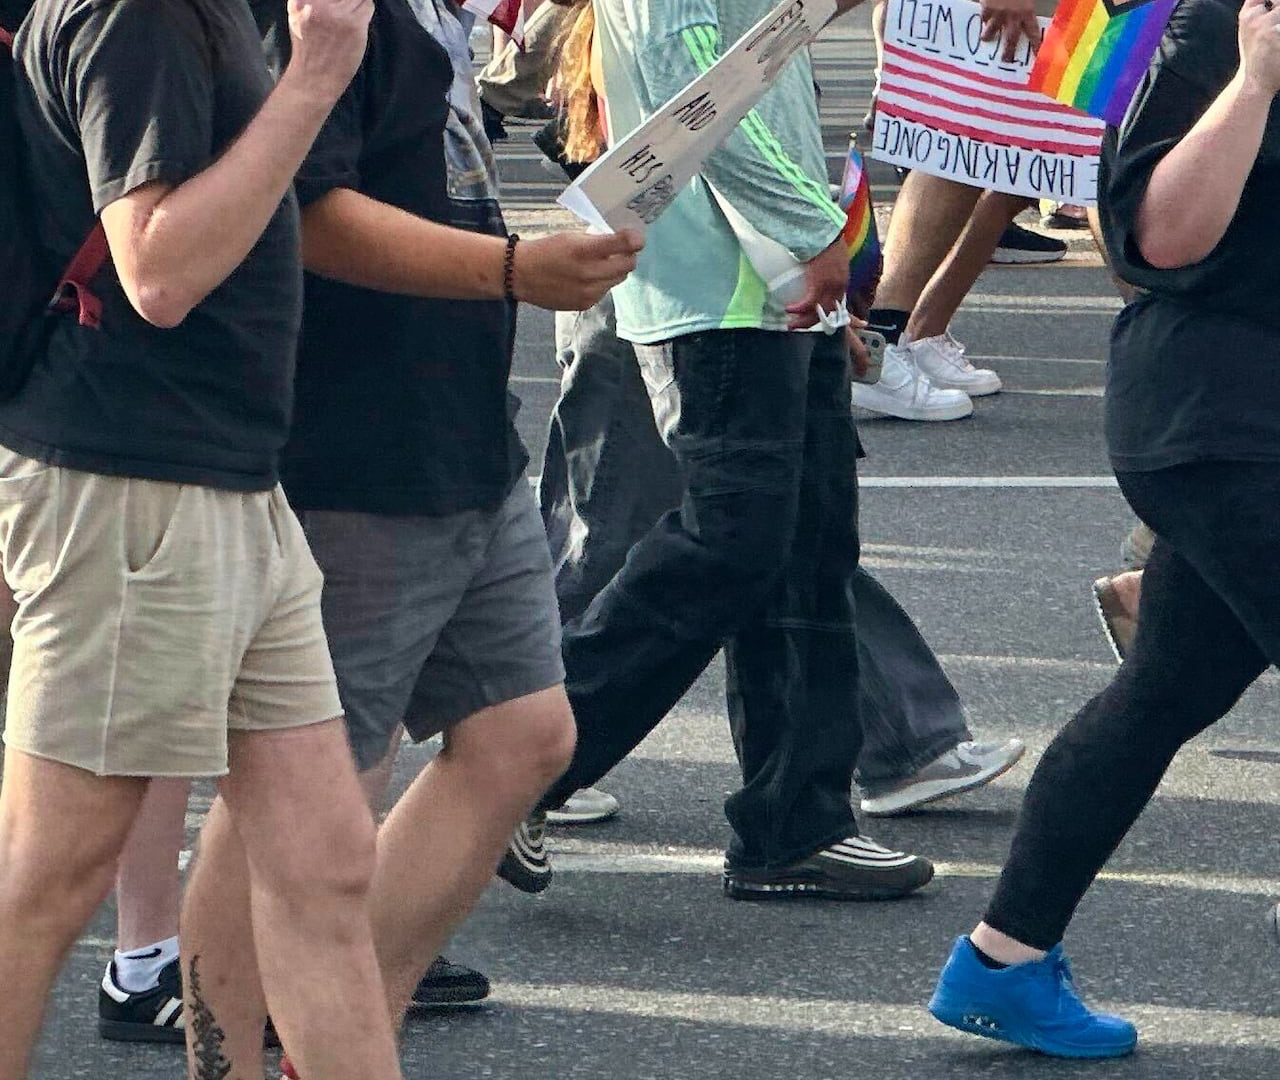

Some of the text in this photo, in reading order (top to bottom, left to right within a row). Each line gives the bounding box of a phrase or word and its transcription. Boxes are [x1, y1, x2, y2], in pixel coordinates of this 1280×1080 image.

[673, 91, 718, 131] AND
[874, 119, 933, 163] ONCE
[938, 134, 1000, 183] KING
[620, 144, 664, 183] HIS
[1005, 151, 1020, 187] A
[1029, 154, 1075, 198] HAD
